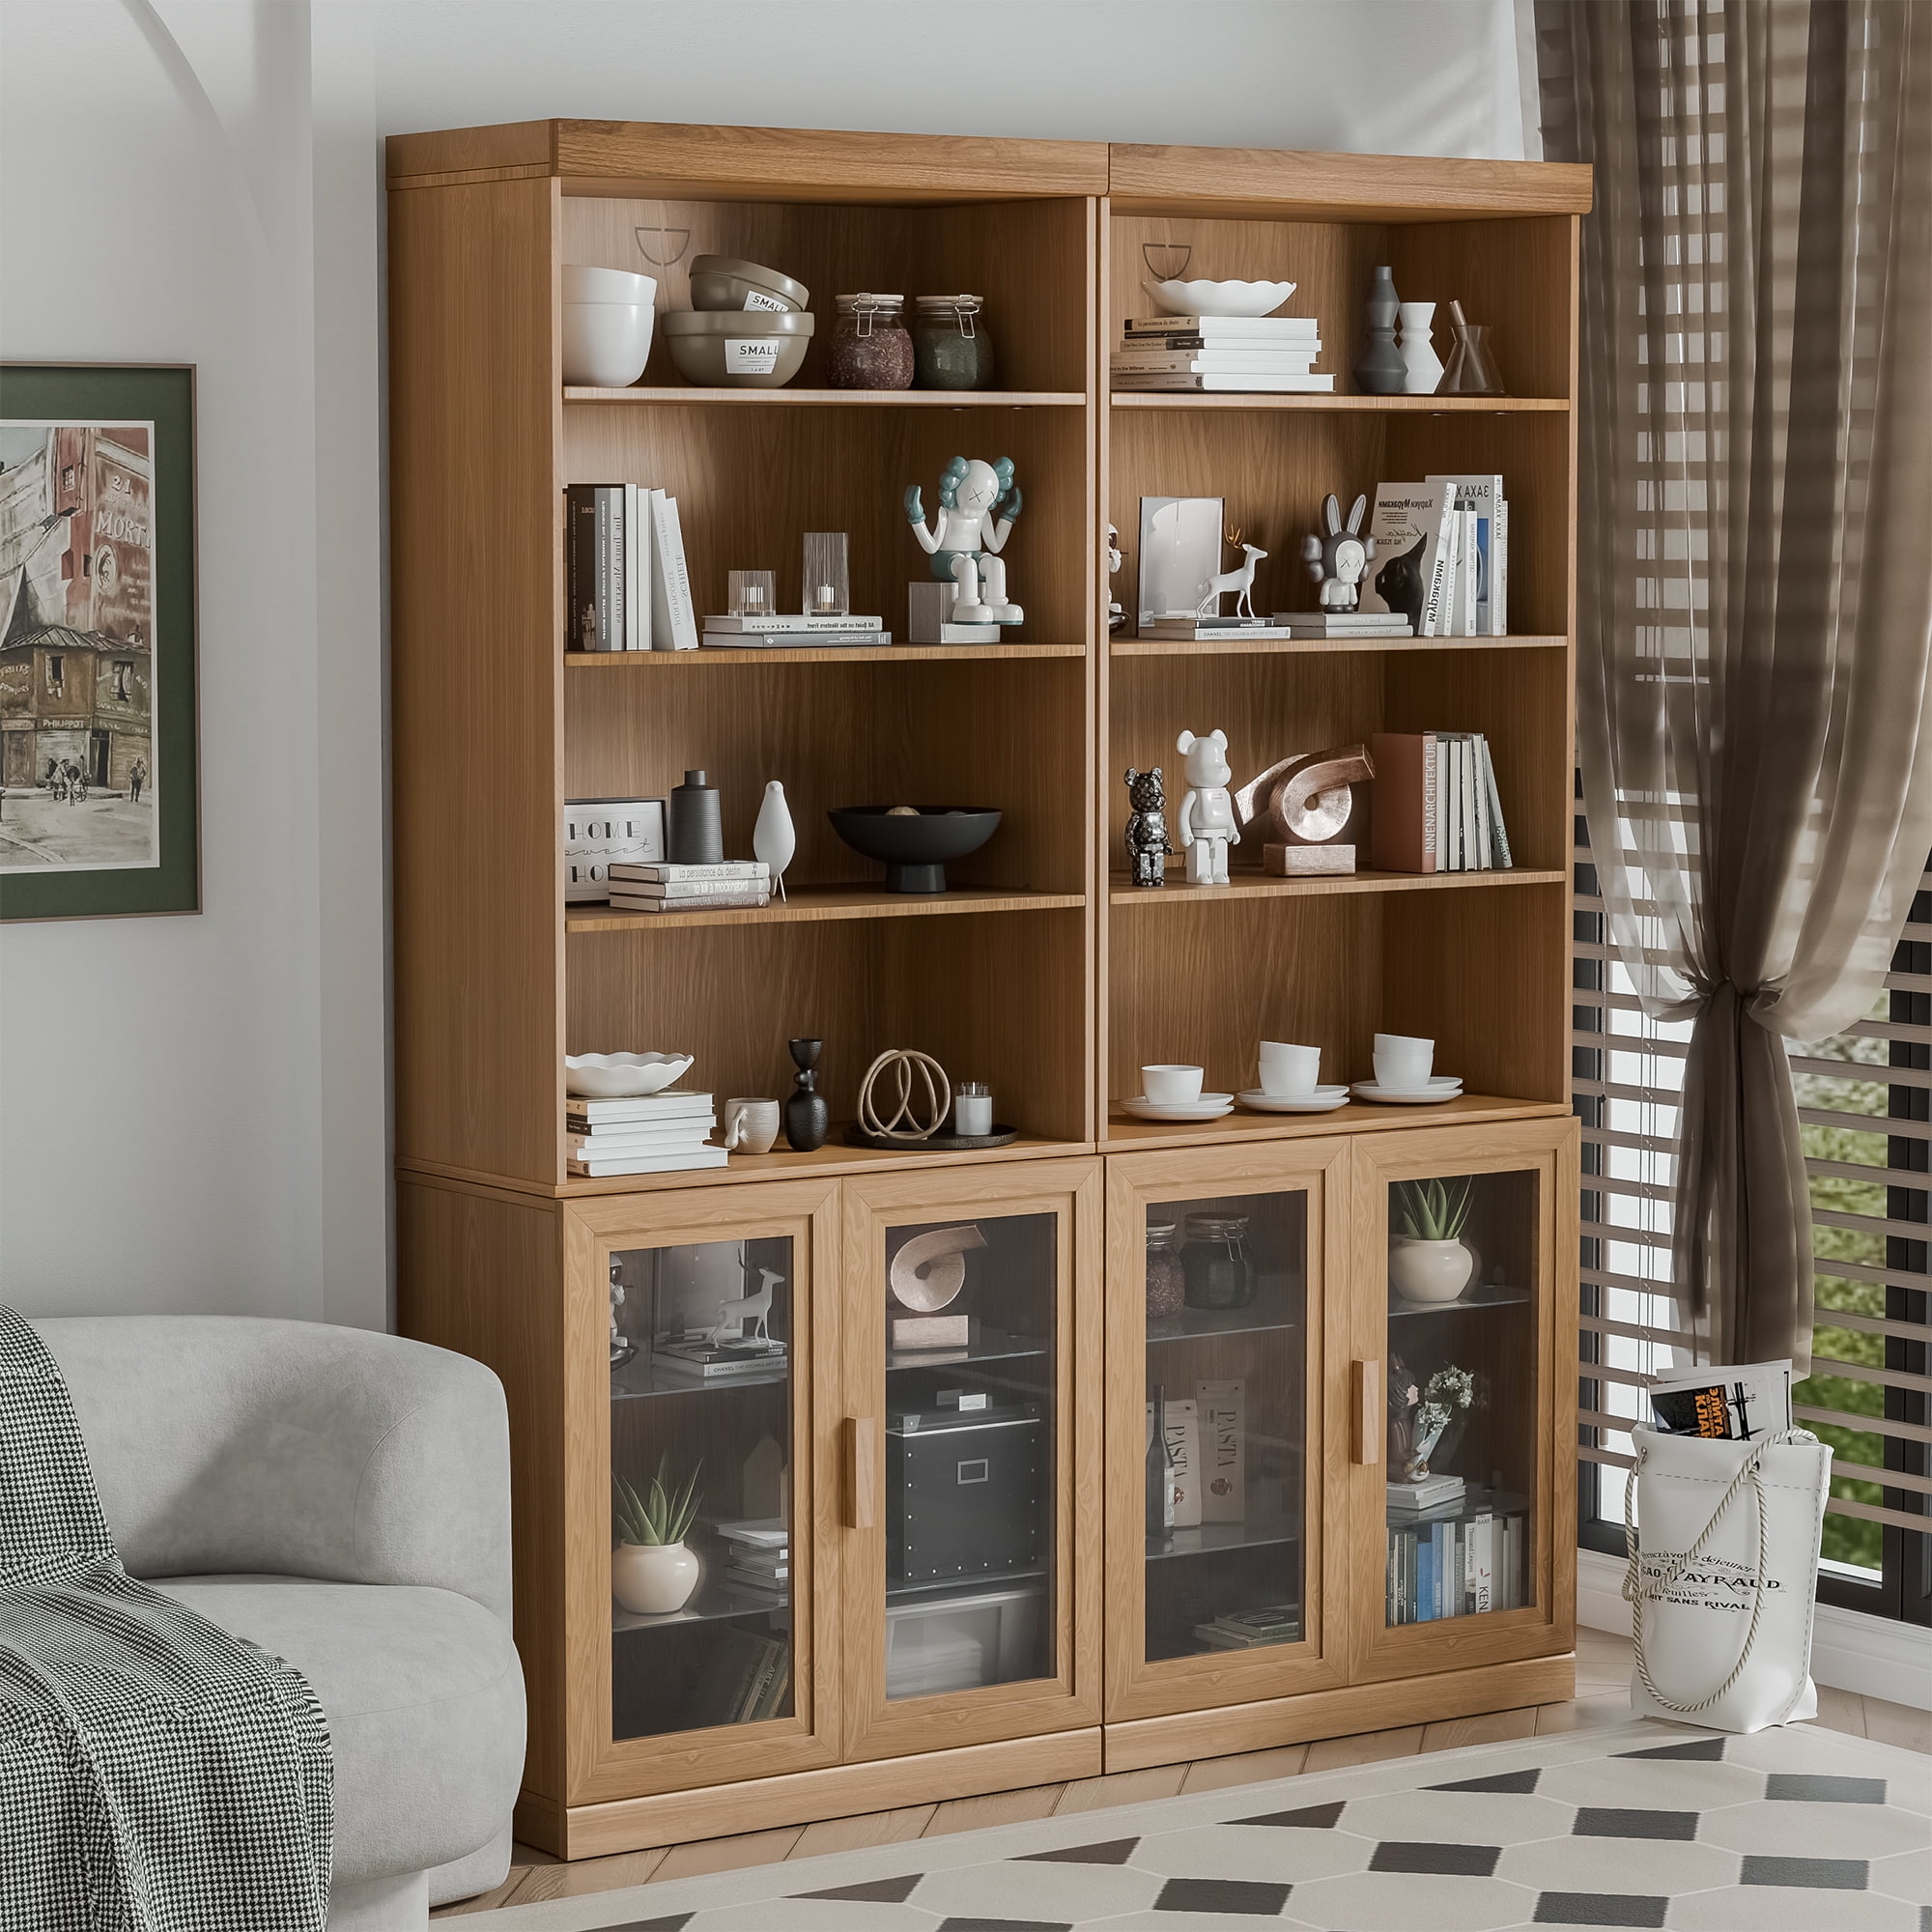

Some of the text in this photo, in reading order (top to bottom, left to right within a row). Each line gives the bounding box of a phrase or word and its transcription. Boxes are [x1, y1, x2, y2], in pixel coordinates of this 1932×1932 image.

[739, 345, 779, 355] SMALL
[112, 475, 132, 495] 21
[1425, 743, 1436, 853] INNENARCHITEKTUR
[569, 820, 641, 840] HOME
[571, 865, 611, 883] HO
[1710, 1387, 1724, 1435] ЭЛИТА
[1217, 1409, 1237, 1467] PASTA
[1479, 1586, 1490, 1613] KEN
[1666, 1596, 1699, 1605] SANS
